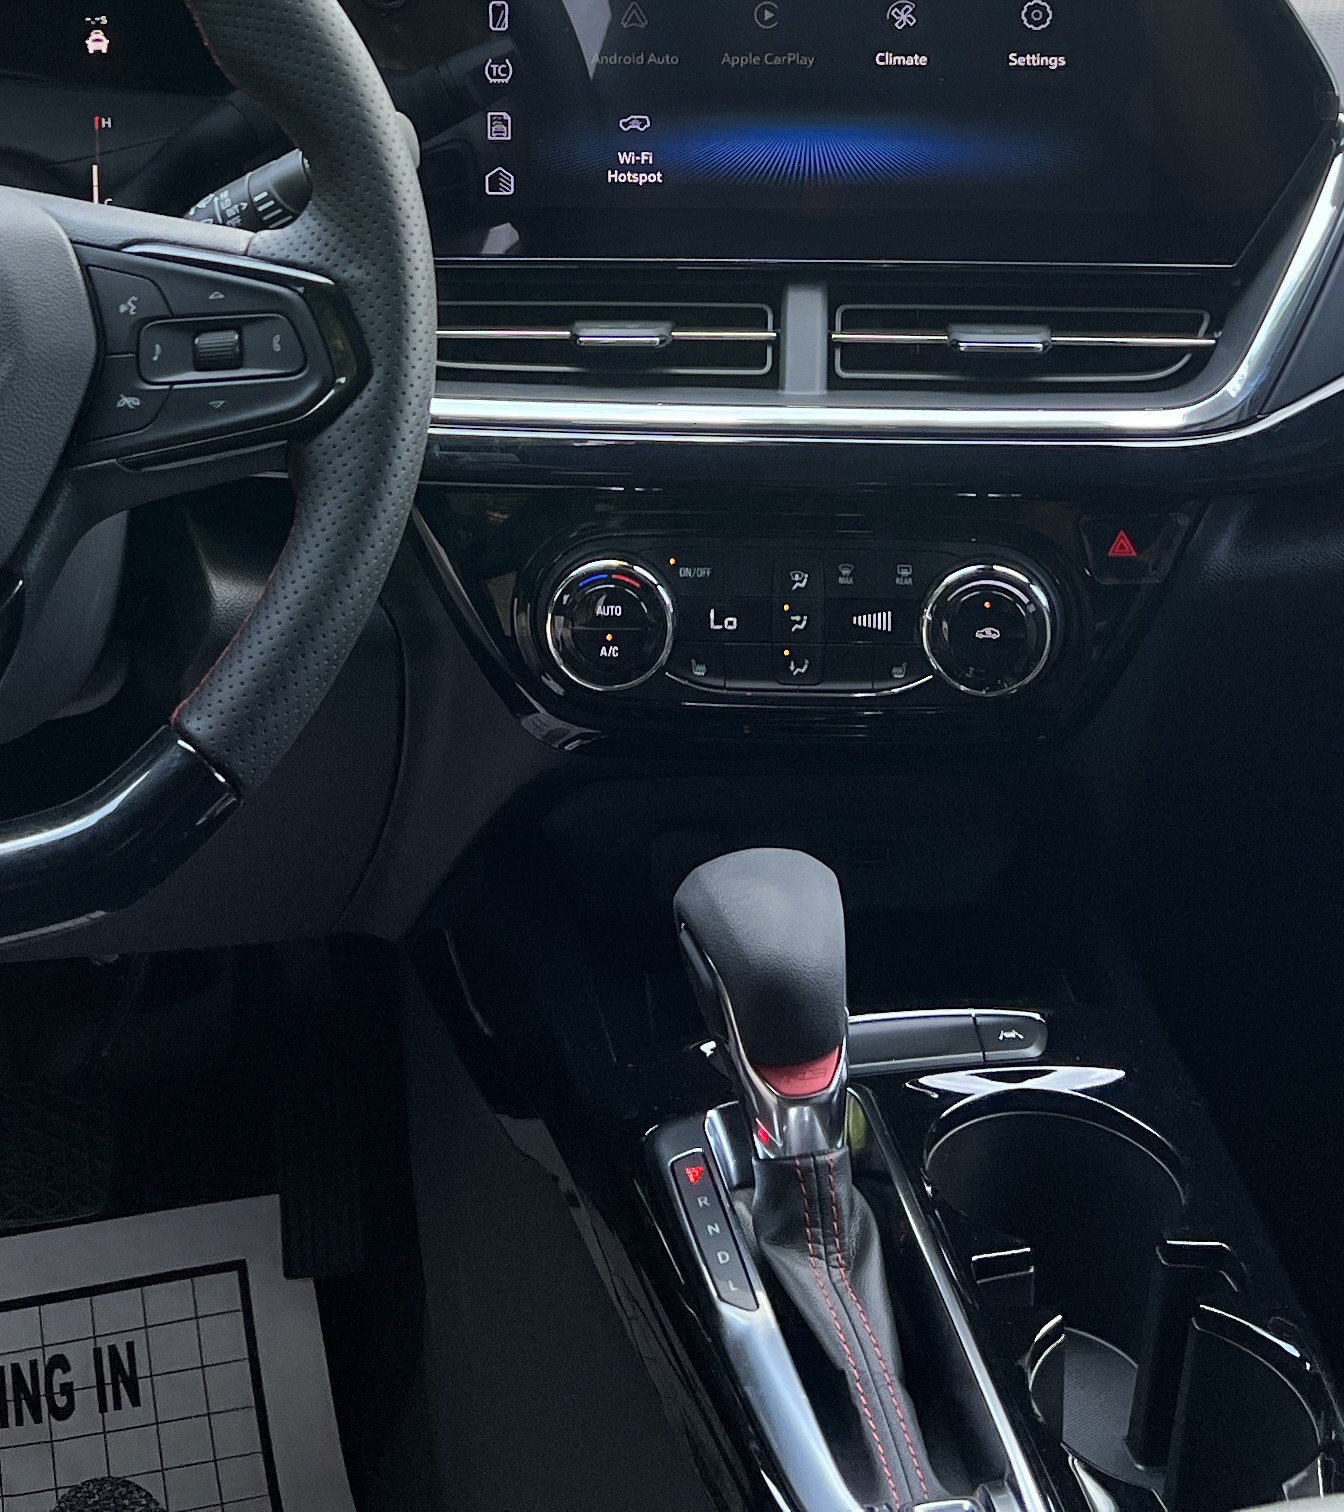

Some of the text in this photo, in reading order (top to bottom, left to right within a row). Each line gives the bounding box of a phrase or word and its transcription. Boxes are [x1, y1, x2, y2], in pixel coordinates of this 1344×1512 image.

[592, 52, 679, 66] Android Auto
[721, 52, 815, 68] Apple CarPlay
[875, 52, 928, 67] Climate
[1008, 53, 1066, 70] Settings
[490, 64, 507, 77] TC
[101, 117, 112, 128] H
[618, 151, 654, 165] Wi-Fi
[607, 170, 663, 186] Hotspot
[679, 567, 712, 578] ON/OFF
[596, 605, 622, 617] AUTO
[709, 608, 738, 630] Lo
[600, 646, 619, 657] A/C
[697, 1196, 710, 1208] R
[707, 1223, 721, 1236] N
[717, 1251, 730, 1265] D
[728, 1279, 738, 1291] L
[92, 1341, 141, 1414] IN
